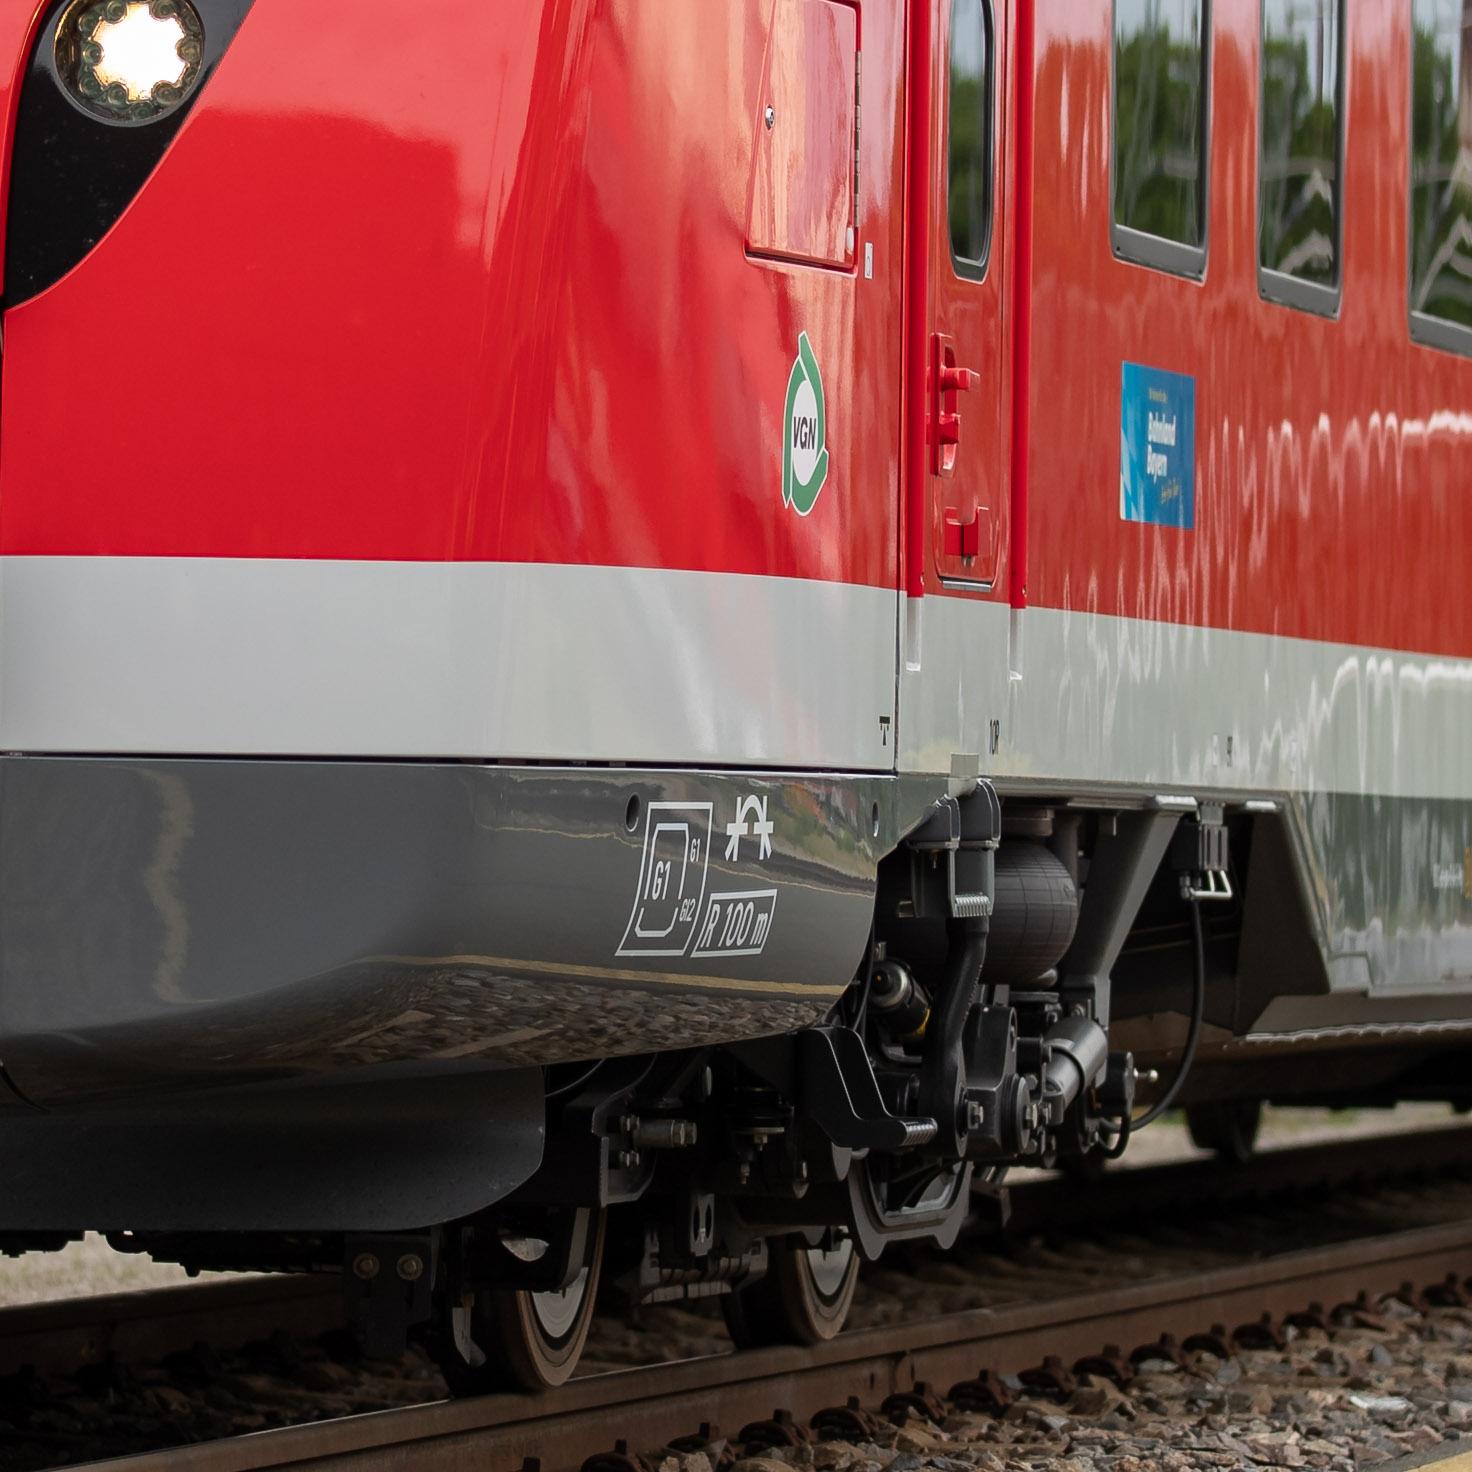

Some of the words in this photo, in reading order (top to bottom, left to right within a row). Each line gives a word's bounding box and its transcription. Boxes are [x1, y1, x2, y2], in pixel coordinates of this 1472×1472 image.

[793, 416, 817, 450] VGN
[690, 839, 701, 863] G1
[651, 861, 672, 901] G1
[700, 903, 721, 948] R
[718, 901, 754, 948] 100
[749, 913, 769, 945] m
